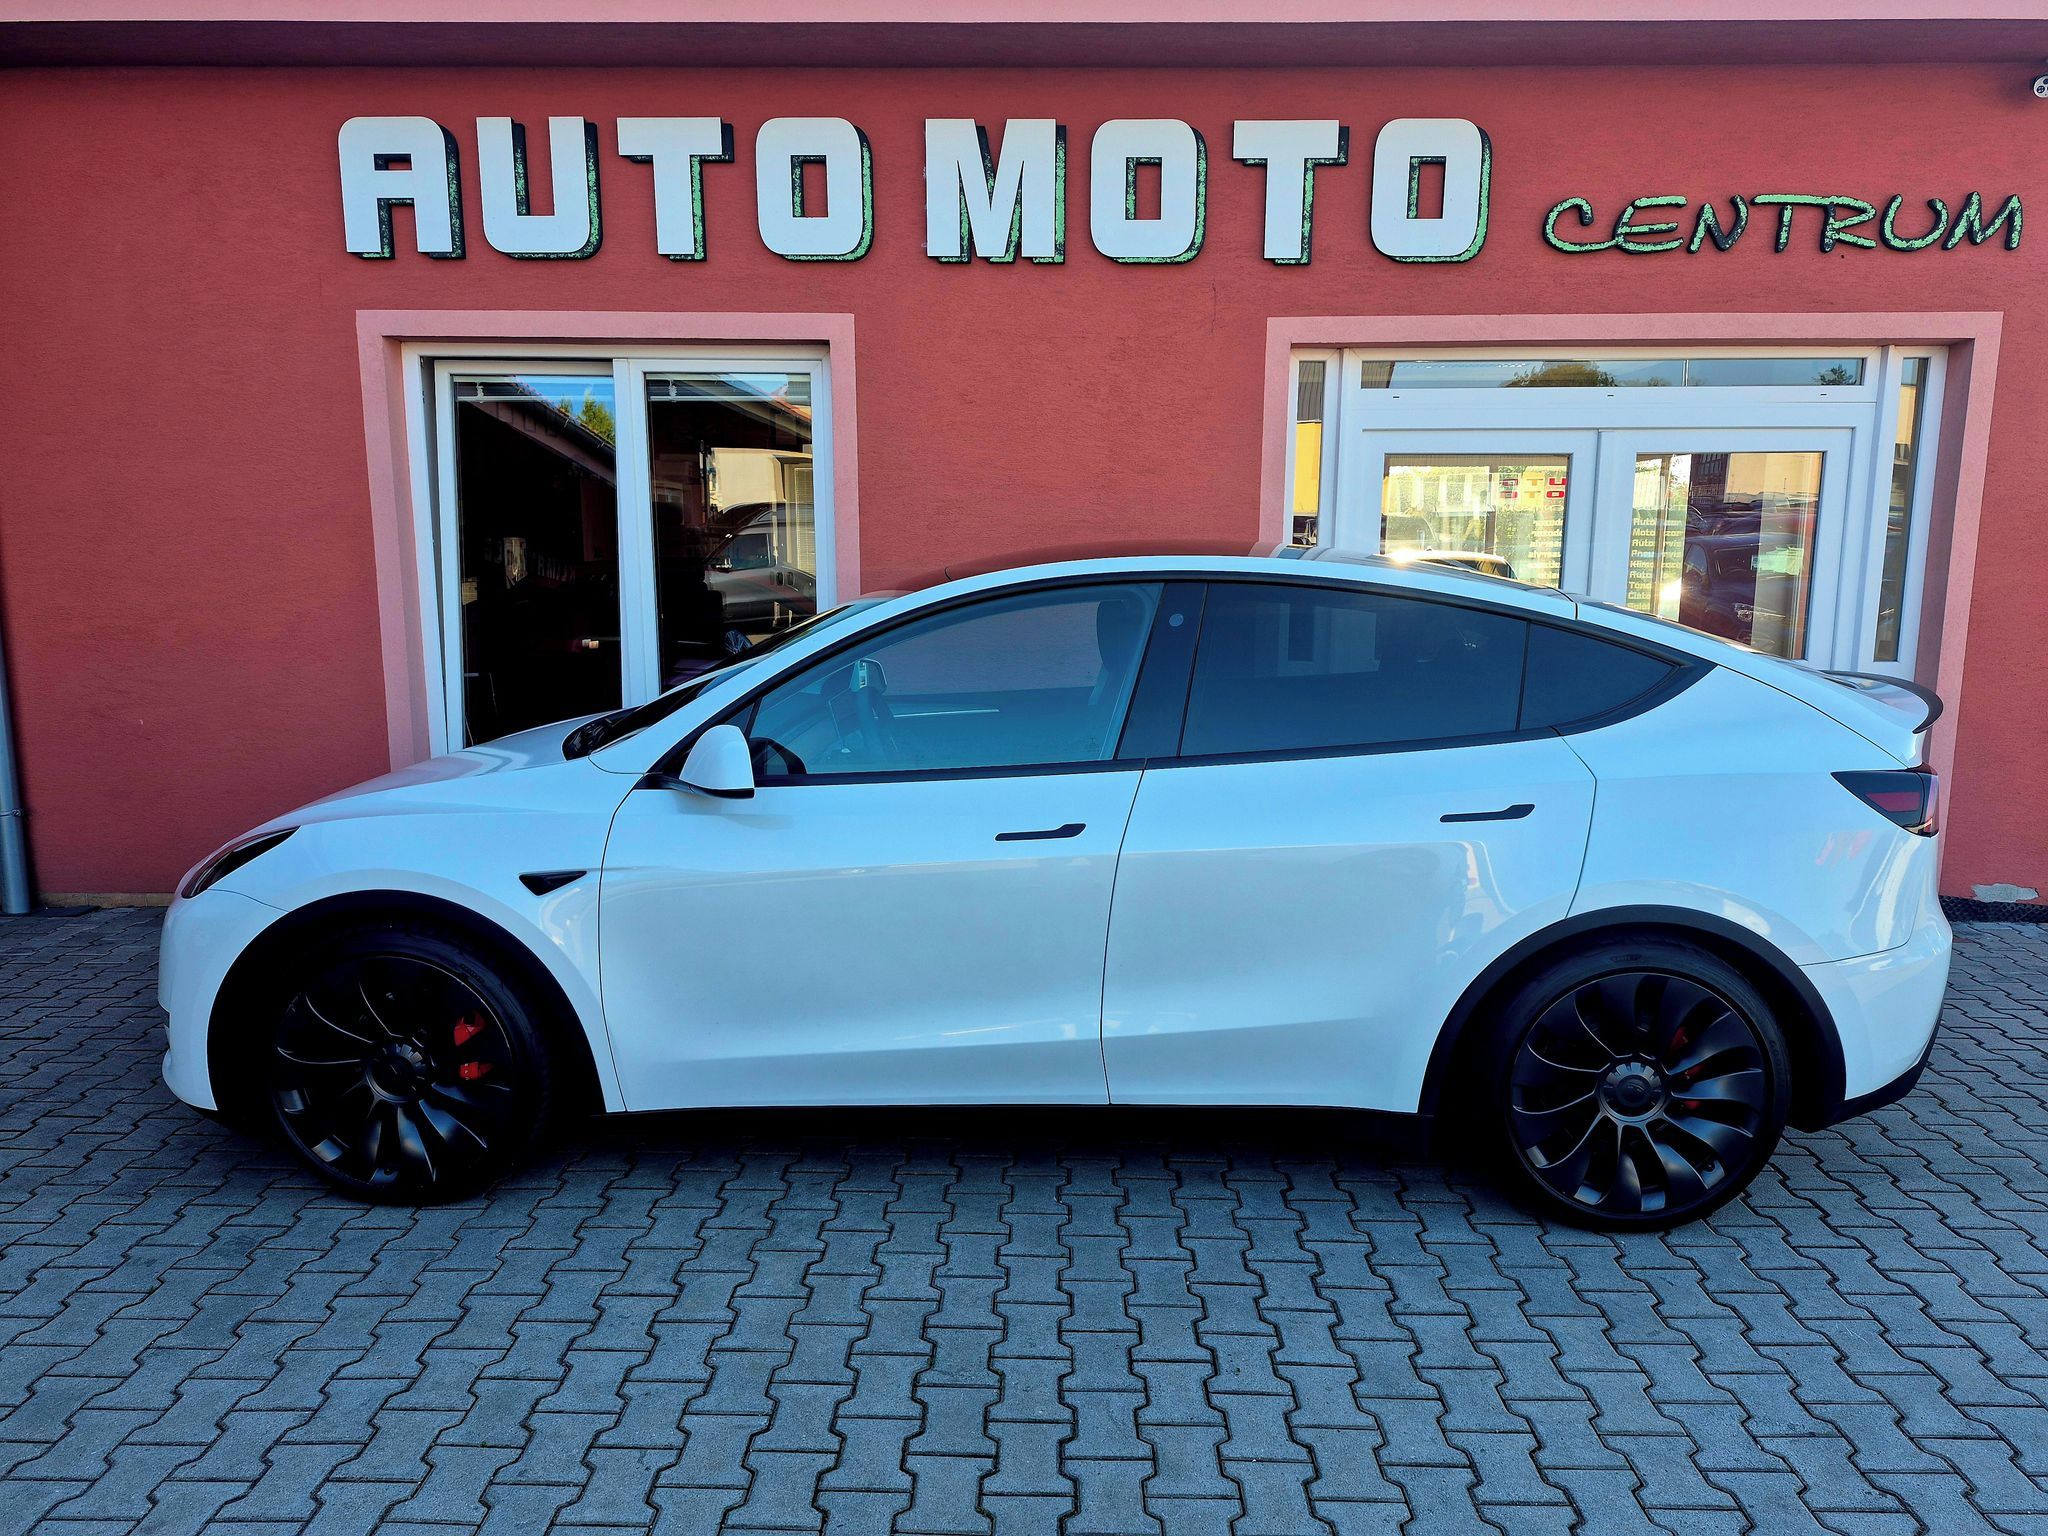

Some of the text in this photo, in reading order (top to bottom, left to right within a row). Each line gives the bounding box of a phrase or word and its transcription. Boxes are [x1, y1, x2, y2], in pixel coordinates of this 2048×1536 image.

[338, 116, 2024, 265] AUTO MOTO CENTRUM
